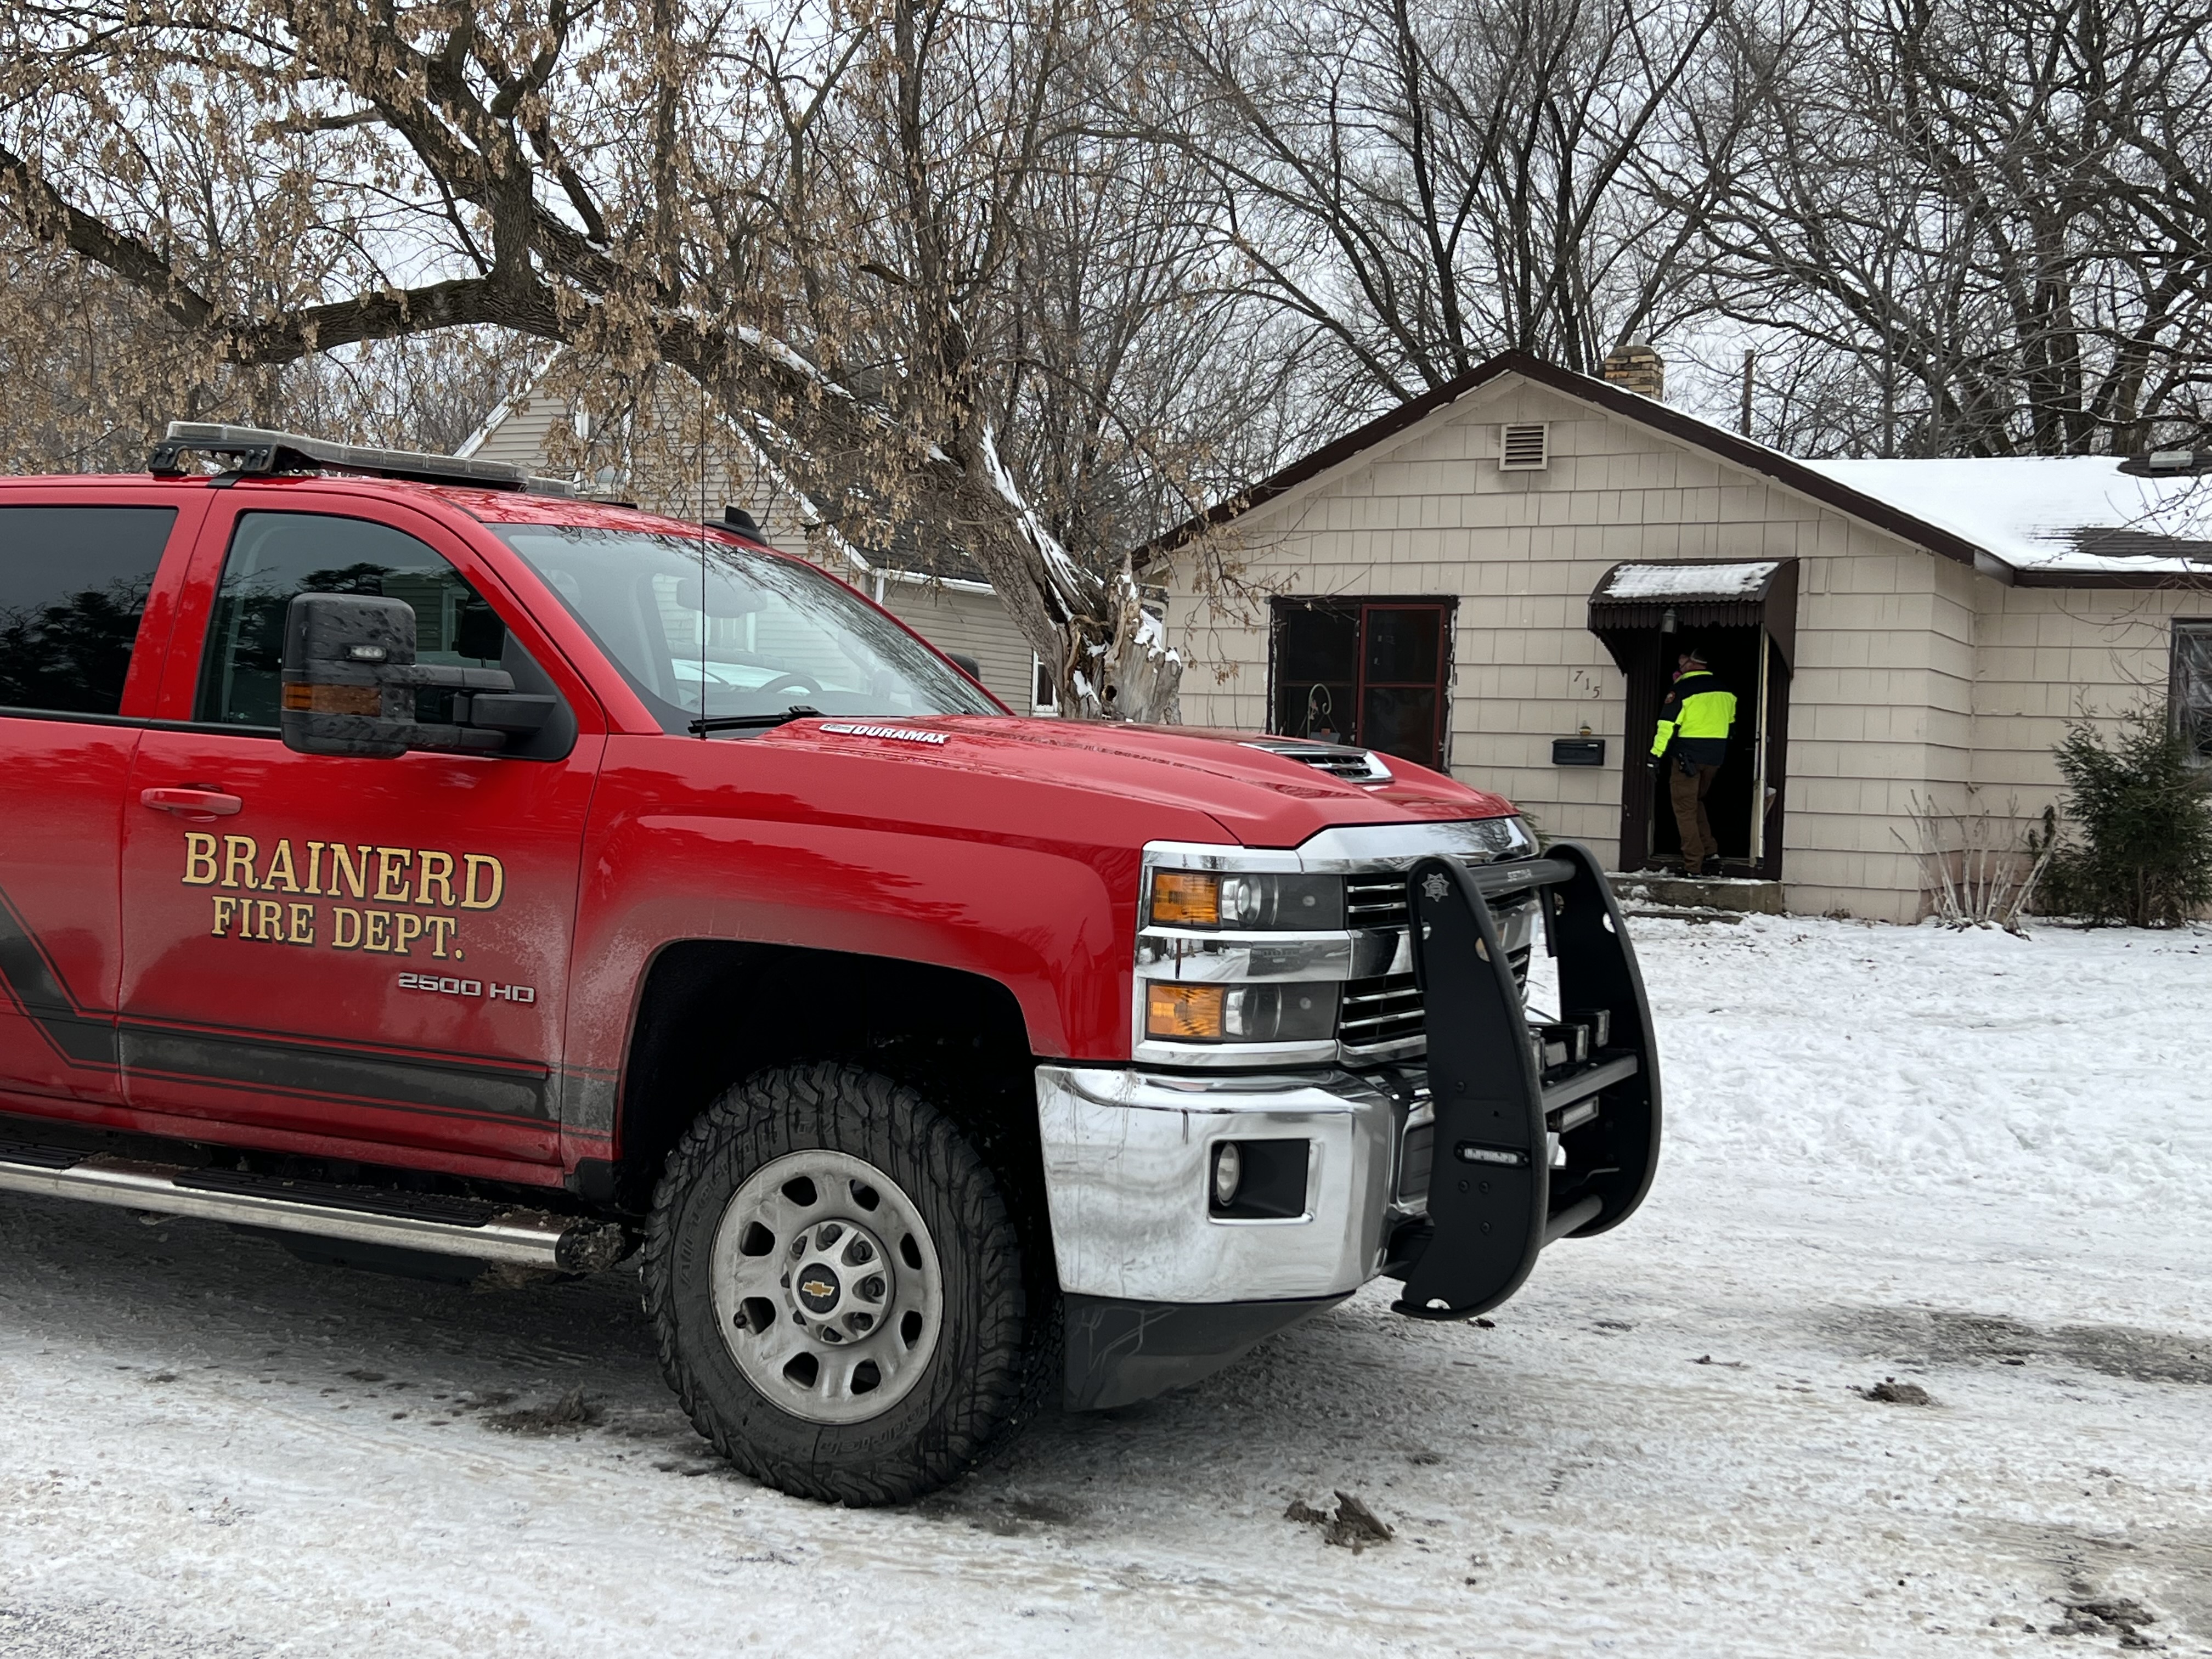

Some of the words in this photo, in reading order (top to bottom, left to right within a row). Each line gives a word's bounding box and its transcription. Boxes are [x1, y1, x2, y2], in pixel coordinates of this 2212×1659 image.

[1573, 670, 1601, 698] 715
[852, 725, 950, 744] DURAMAX
[181, 832, 505, 910] BRAINERD
[211, 895, 314, 945] FIRE
[332, 906, 464, 960] DEPT.
[398, 972, 481, 996] 2500
[489, 982, 535, 1003] HD
